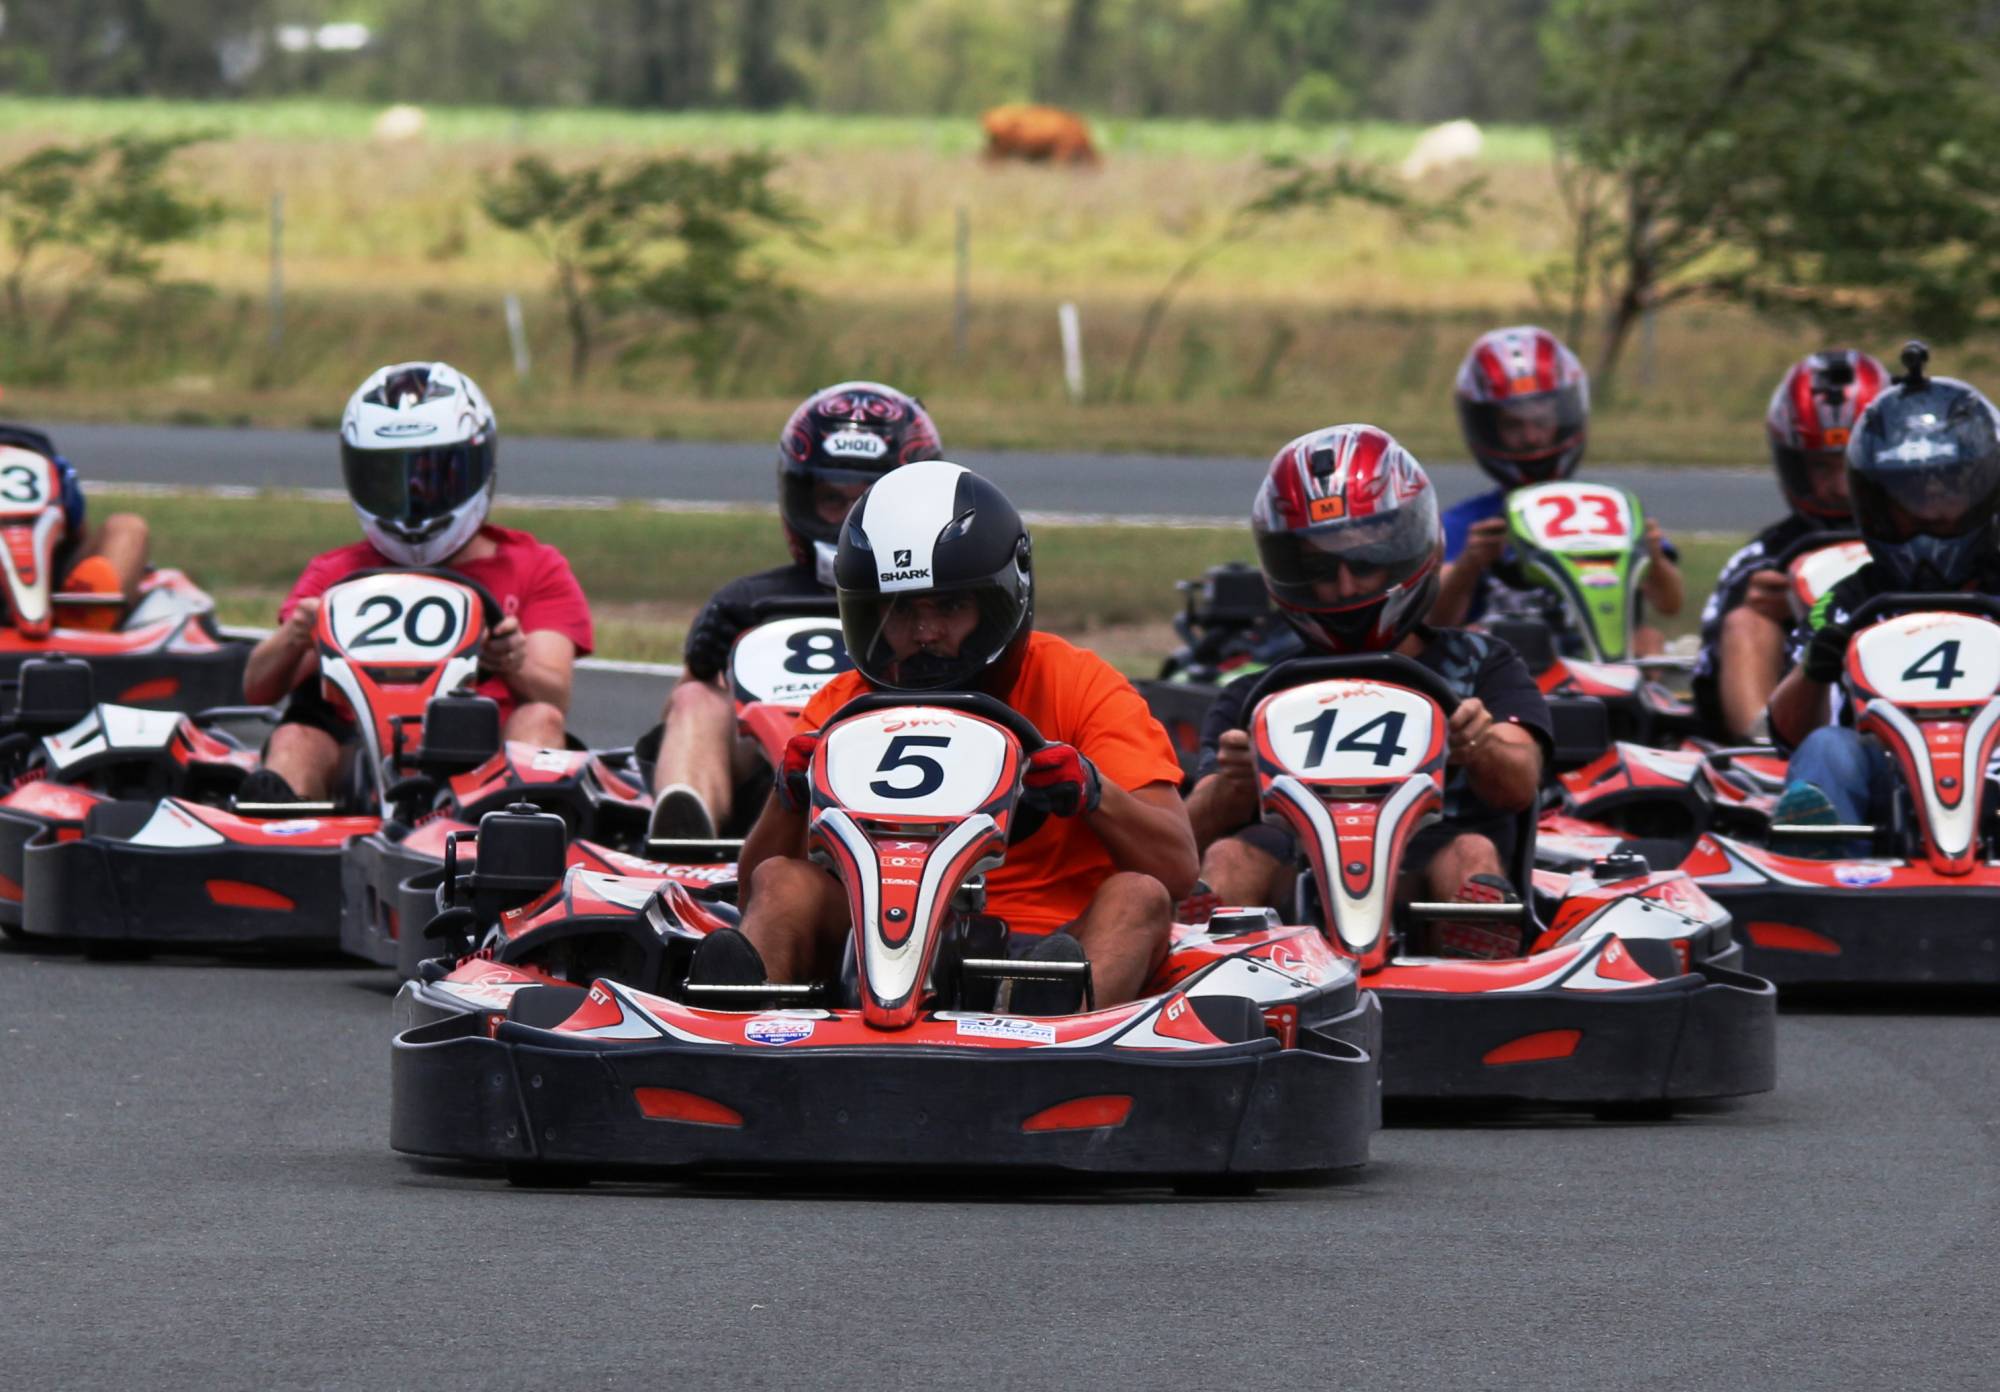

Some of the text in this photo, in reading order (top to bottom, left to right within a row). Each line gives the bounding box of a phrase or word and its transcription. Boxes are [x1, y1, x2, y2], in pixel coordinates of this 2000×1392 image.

[834, 438, 878, 453] SHOEI
[1, 464, 40, 503] 3
[1320, 502, 1334, 513] M
[1537, 494, 1626, 538] 23
[880, 568, 930, 582] SHARK
[348, 594, 457, 649] 20
[783, 627, 857, 675] 8
[1901, 639, 1965, 690] 4
[1293, 708, 1407, 769] 14
[869, 735, 951, 799] 5
[589, 987, 611, 1005] GT
[1167, 996, 1186, 1021] GT
